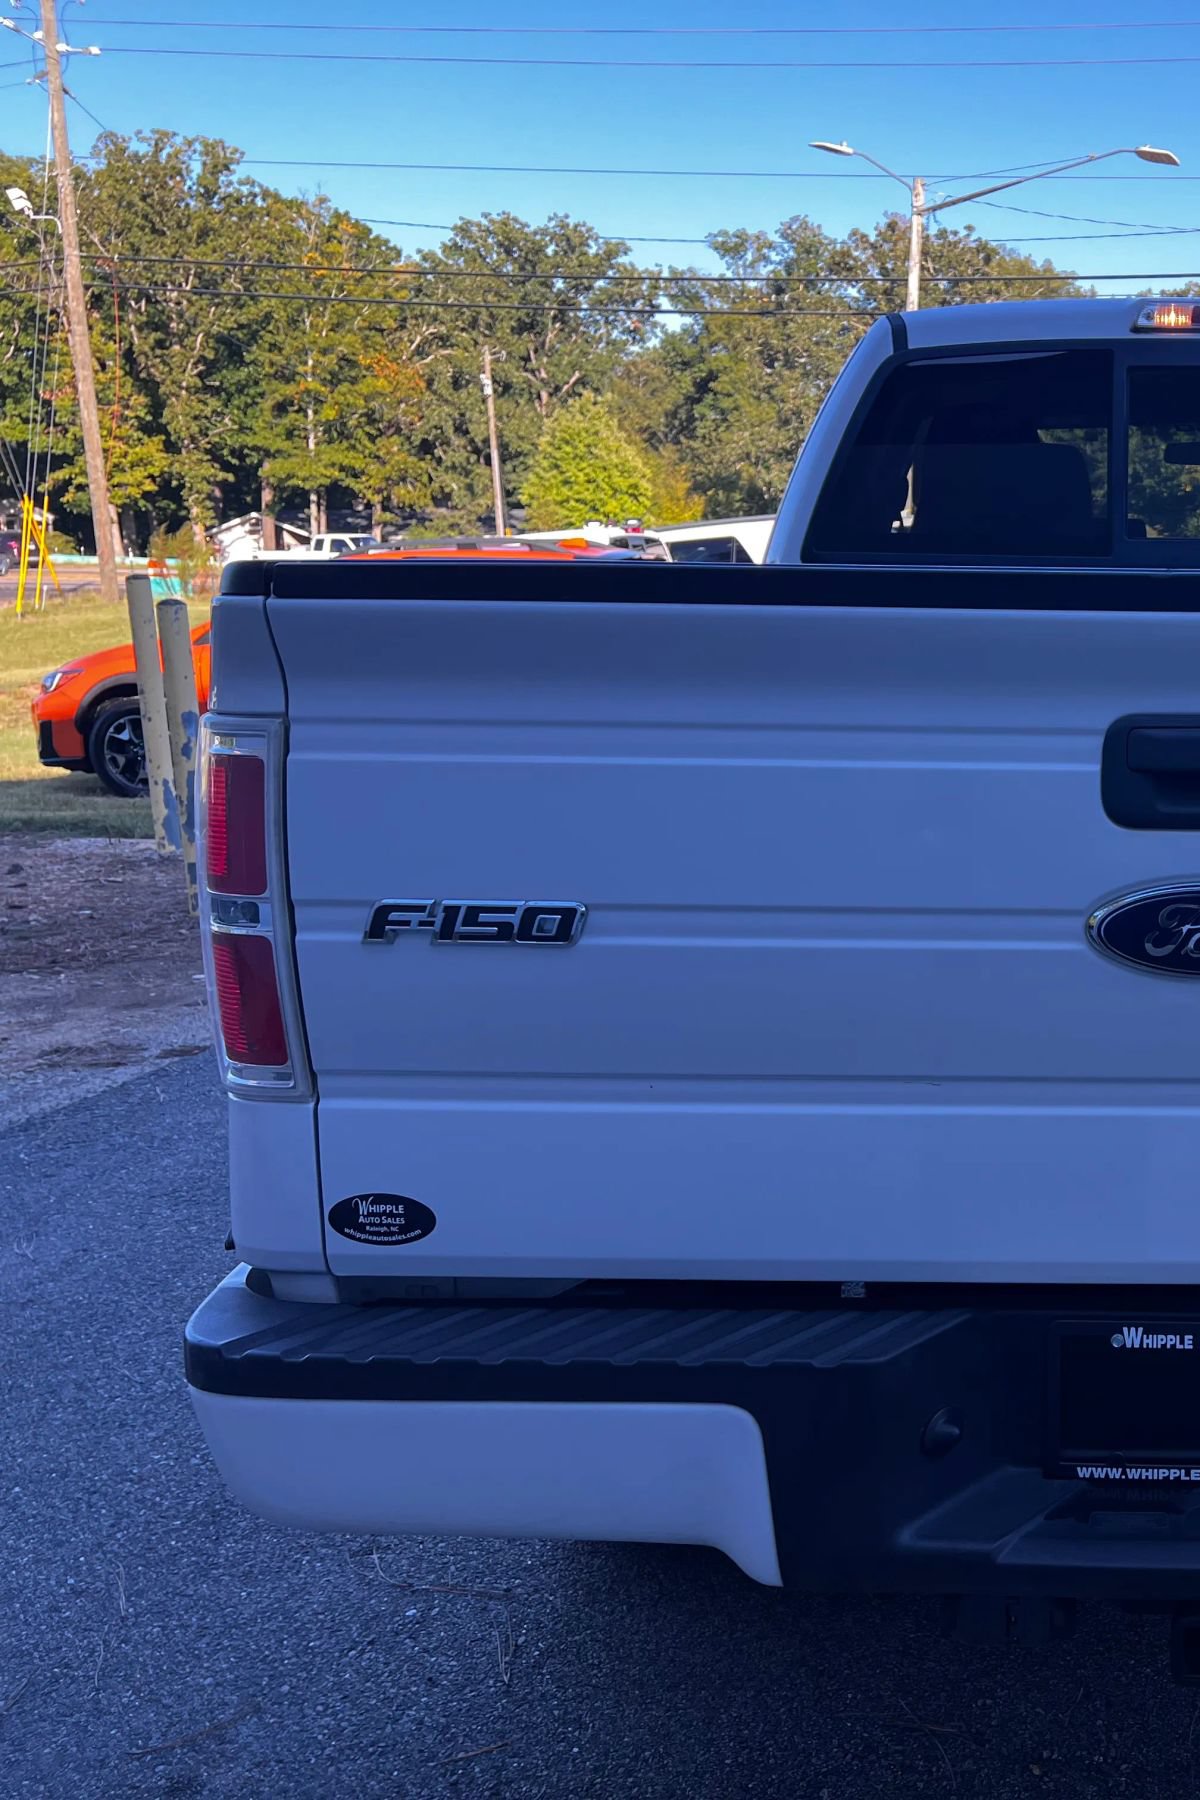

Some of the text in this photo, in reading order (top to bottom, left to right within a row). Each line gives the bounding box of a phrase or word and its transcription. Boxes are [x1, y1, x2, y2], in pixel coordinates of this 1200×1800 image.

[362, 898, 588, 945] F-150
[352, 1196, 405, 1215] WHIPPLE
[358, 1215, 405, 1224] AUTO SALES
[344, 1227, 421, 1241] whippleautosales.com
[1122, 1326, 1193, 1349] WHIPPLE
